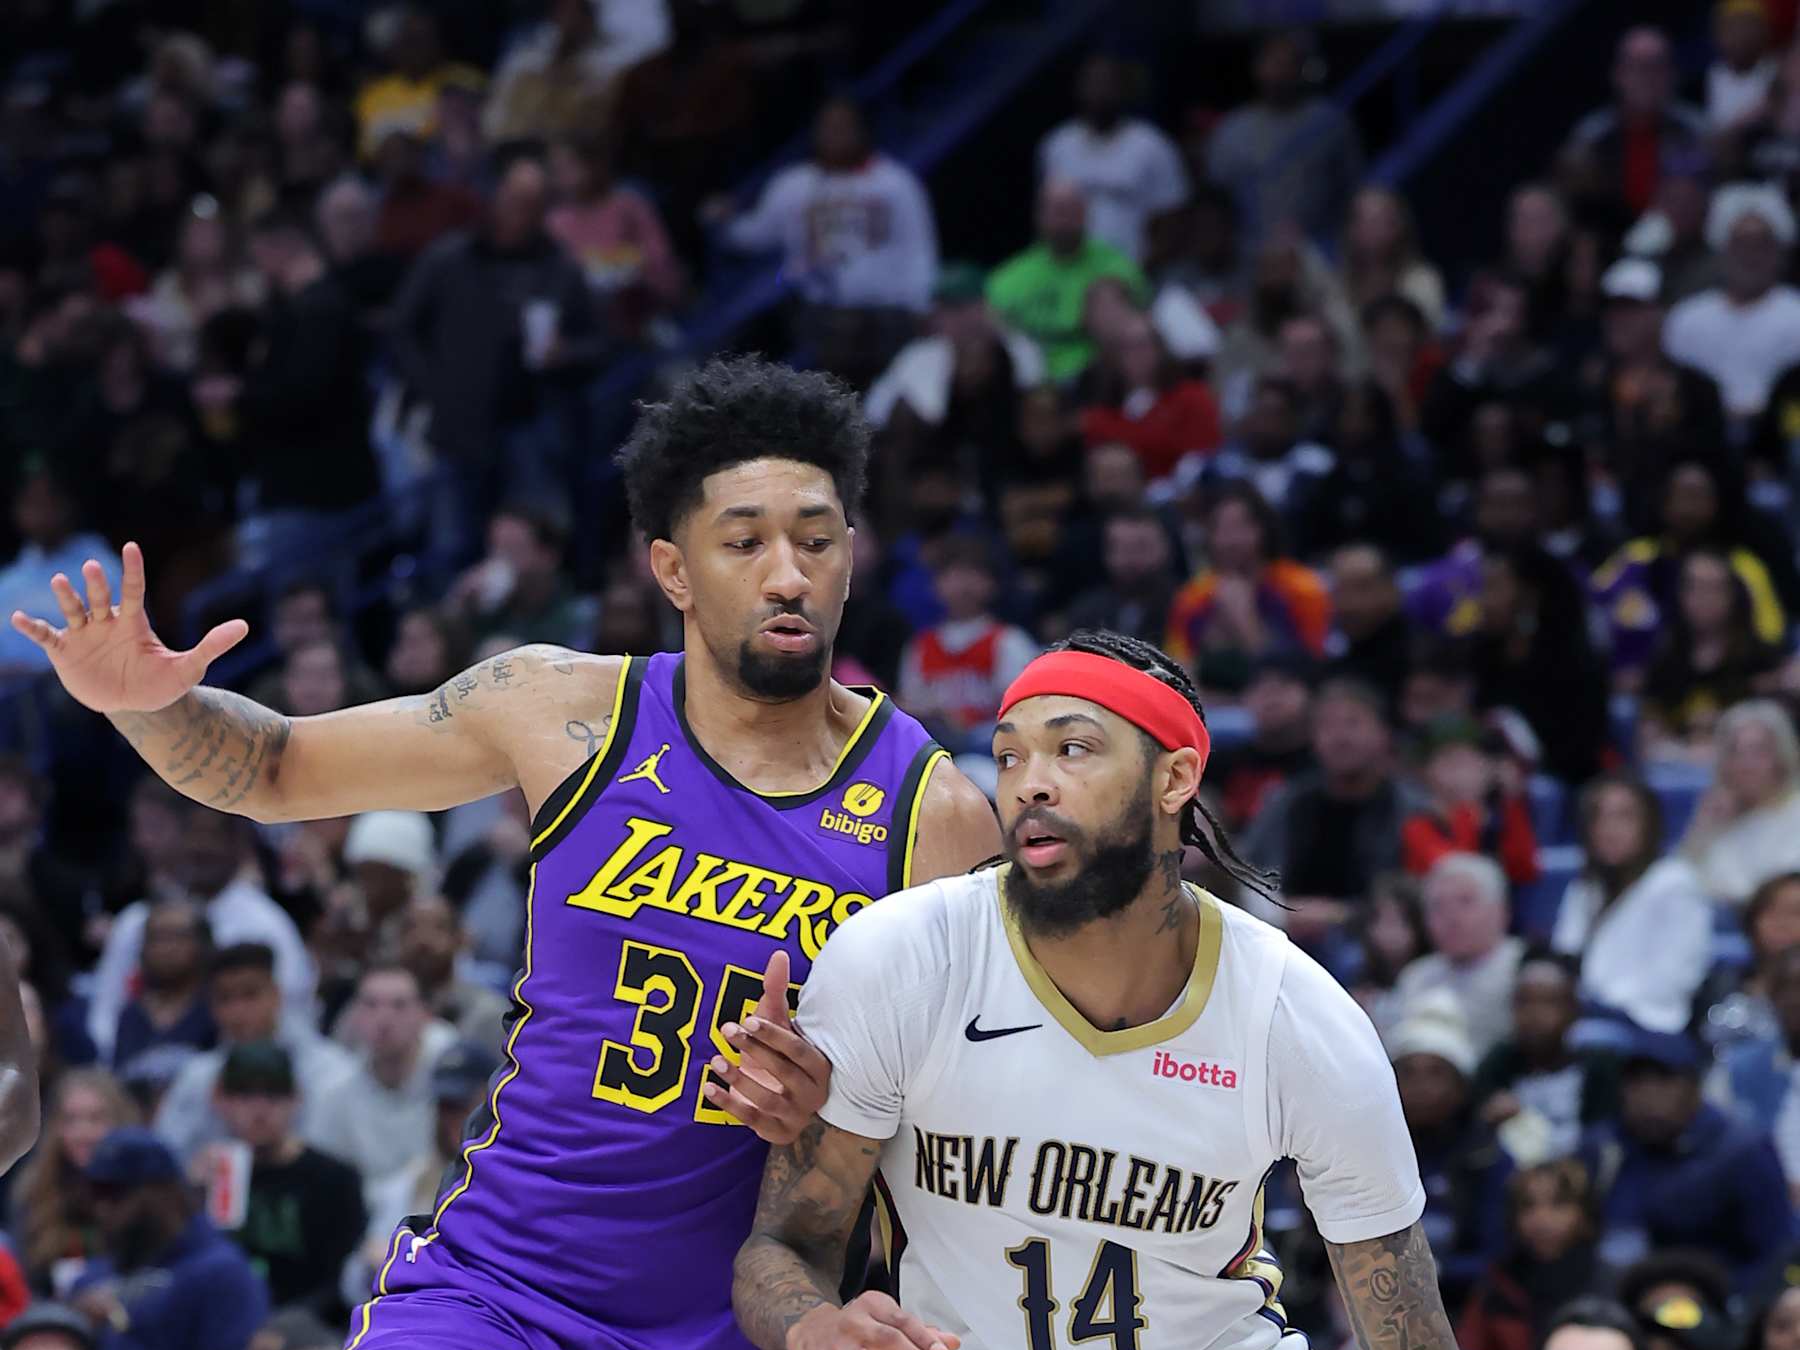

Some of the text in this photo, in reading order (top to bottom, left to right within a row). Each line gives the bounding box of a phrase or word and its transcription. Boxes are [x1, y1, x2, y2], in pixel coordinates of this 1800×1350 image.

[819, 808, 888, 844] bibigo
[566, 817, 874, 960] LAKERS
[1152, 1051, 1237, 1089] ibotta
[913, 1125, 1239, 1233] NEW ORLEANS
